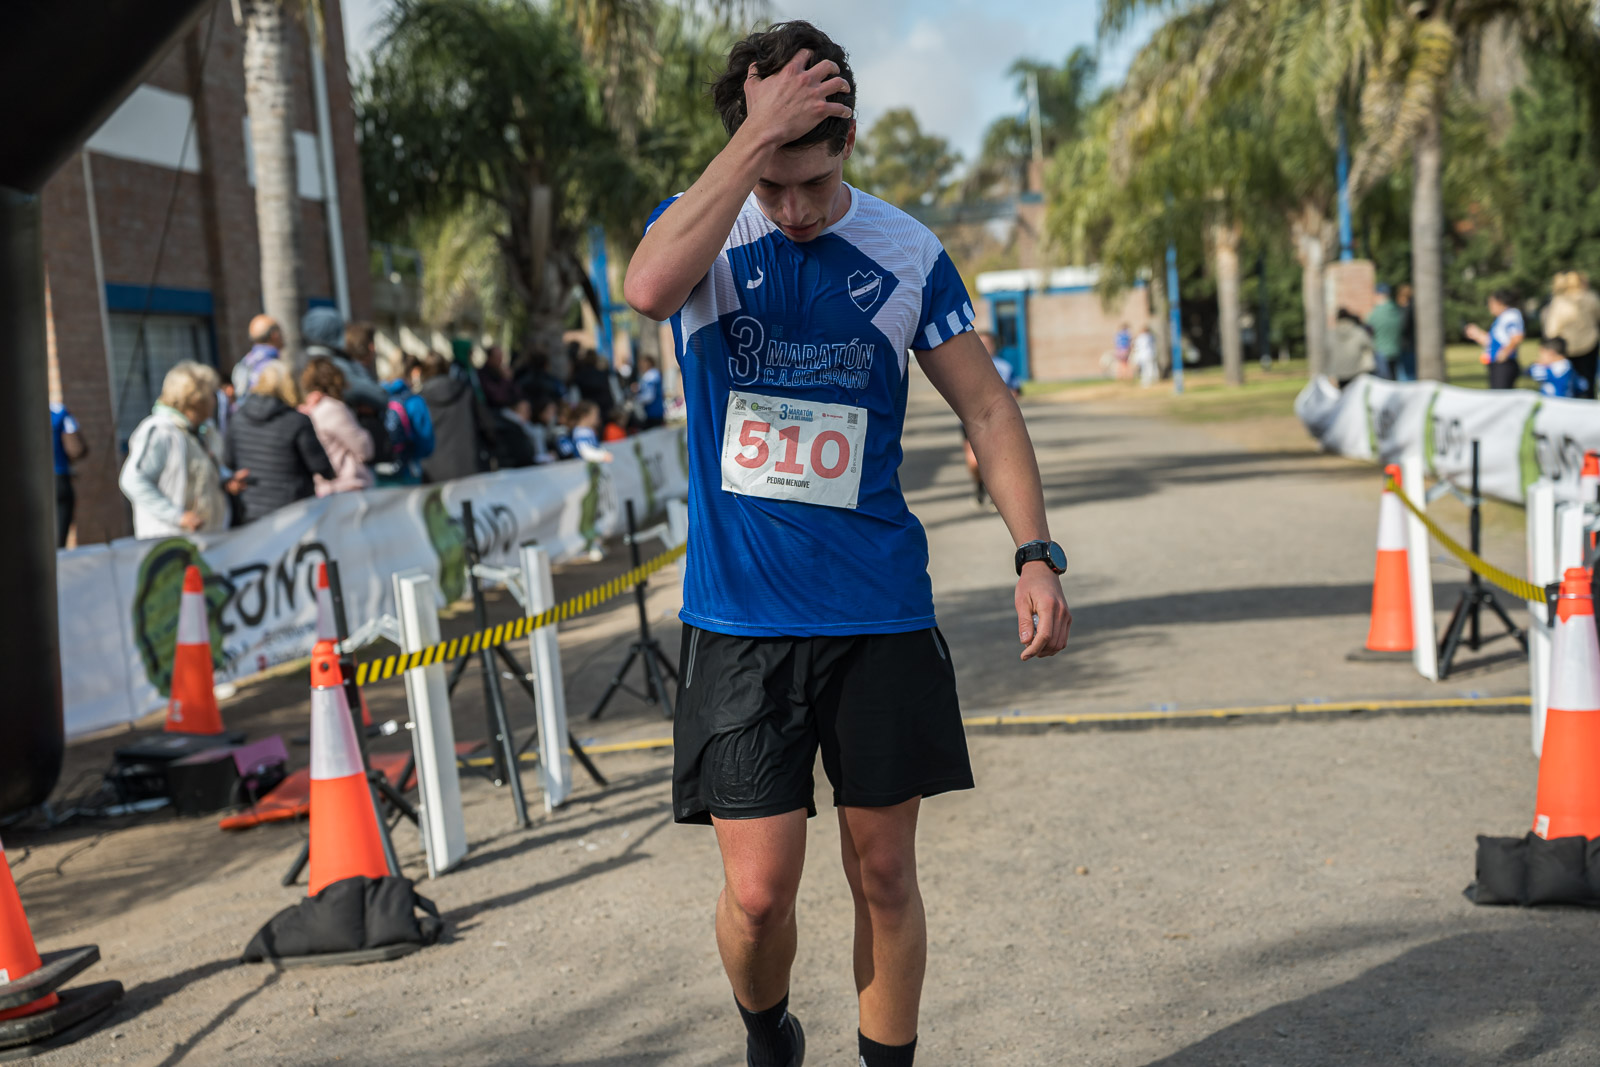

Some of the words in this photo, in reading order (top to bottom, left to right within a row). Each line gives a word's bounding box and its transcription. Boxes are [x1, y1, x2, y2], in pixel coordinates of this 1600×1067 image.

[728, 315, 764, 386] 3
[765, 338, 875, 370] MARATÓN
[779, 403, 788, 420] 3
[788, 408, 813, 417] MARATÓN
[734, 419, 850, 479] 510
[766, 476, 785, 485] PEDRO
[785, 478, 810, 489] MENDIVE
